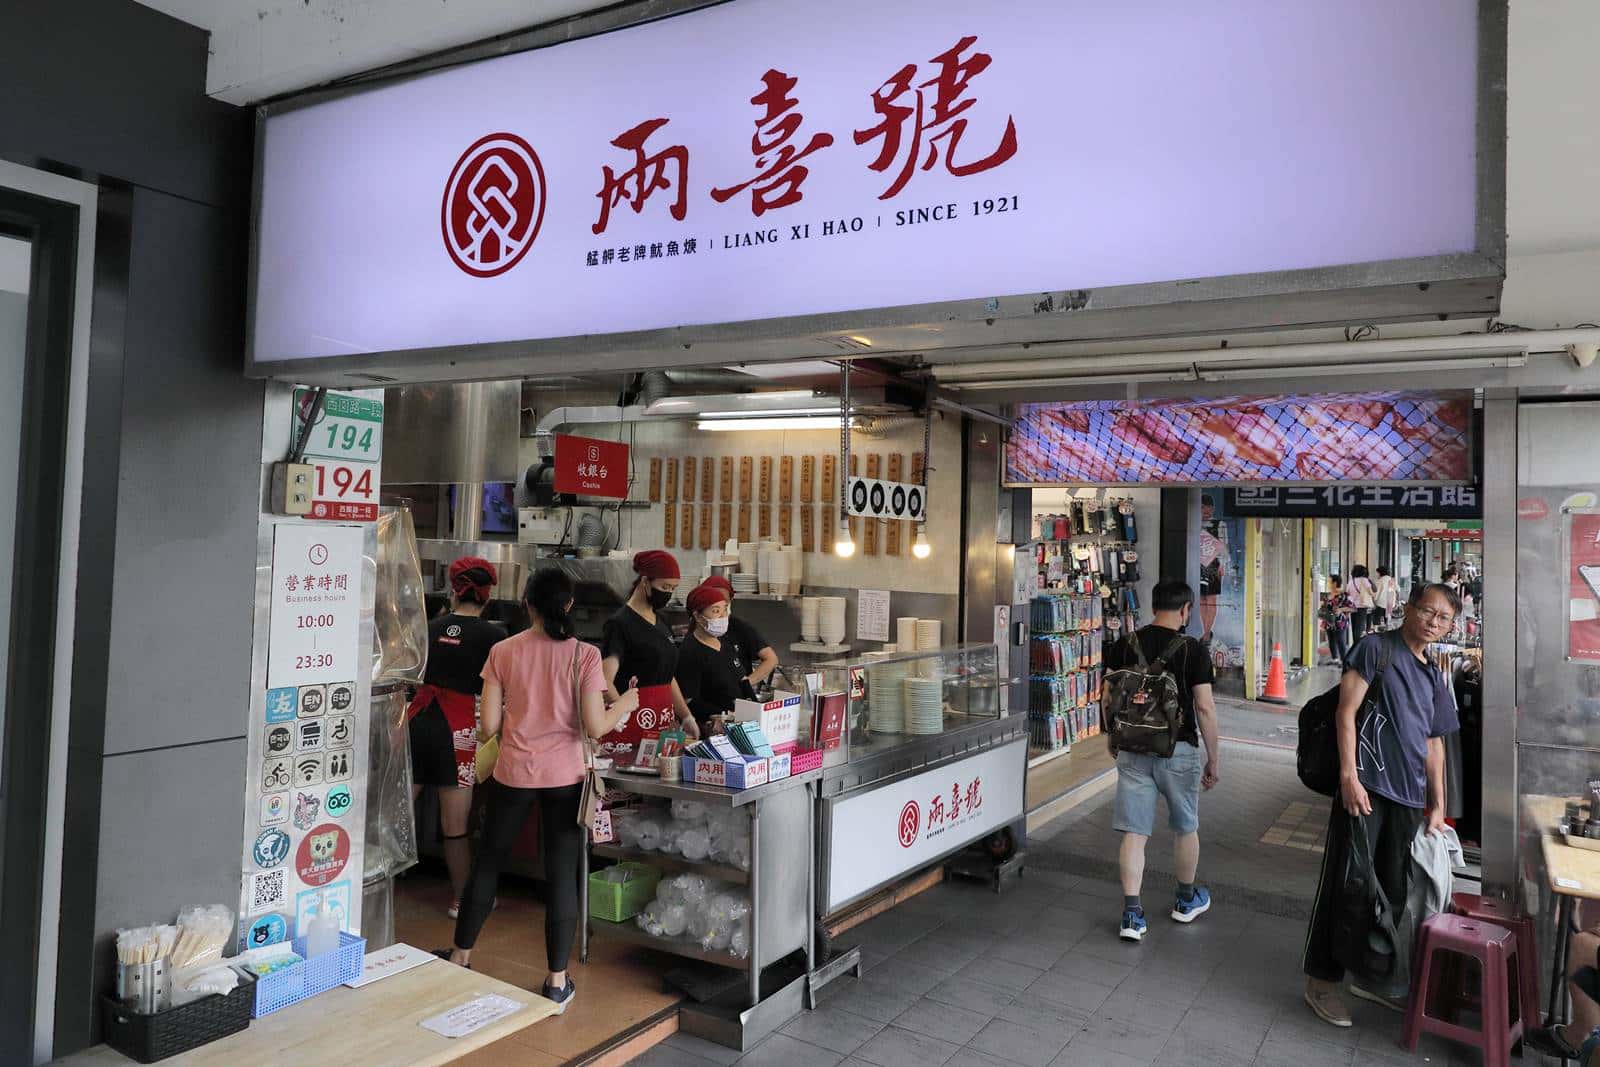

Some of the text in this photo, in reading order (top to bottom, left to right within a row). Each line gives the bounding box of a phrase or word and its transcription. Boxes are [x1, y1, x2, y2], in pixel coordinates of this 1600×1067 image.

[591, 36, 1018, 234] 兩喜號
[895, 195, 1019, 226] SINCE 1921
[724, 217, 864, 248] LIANG XI HAO
[327, 424, 373, 452] 194
[577, 463, 608, 479] 收銀台
[315, 465, 373, 499] 194
[285, 573, 348, 592] 營業時間
[285, 594, 322, 603] Business
[297, 614, 335, 629] 10:00
[295, 654, 333, 670] 23:30
[304, 694, 320, 706] EN
[302, 739, 319, 747] PAY
[927, 776, 983, 830] 兩喜號
